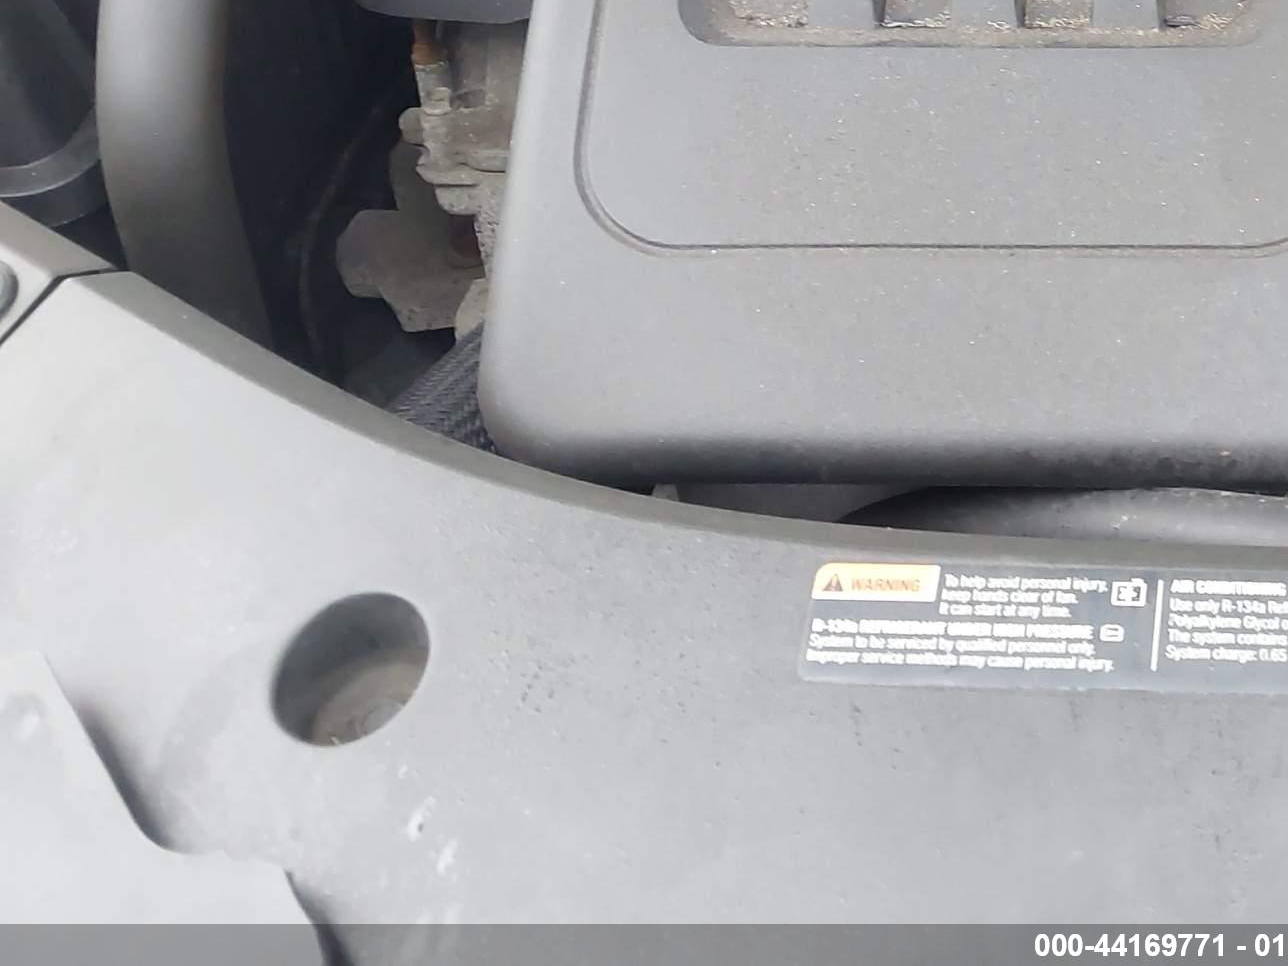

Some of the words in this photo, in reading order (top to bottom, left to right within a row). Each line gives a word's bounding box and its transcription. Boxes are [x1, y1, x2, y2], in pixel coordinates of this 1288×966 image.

[851, 577, 921, 592] WARNING
[1021, 577, 1071, 592] personal
[1170, 598, 1193, 611] Use
[1194, 599, 1220, 614] only
[1222, 599, 1266, 613] R-134a
[1243, 616, 1280, 631] Glycol
[1168, 628, 1191, 643] The
[1192, 631, 1235, 646] system
[1166, 644, 1211, 661] System
[1259, 648, 1288, 662] 0.65
[1024, 657, 1077, 670] personal
